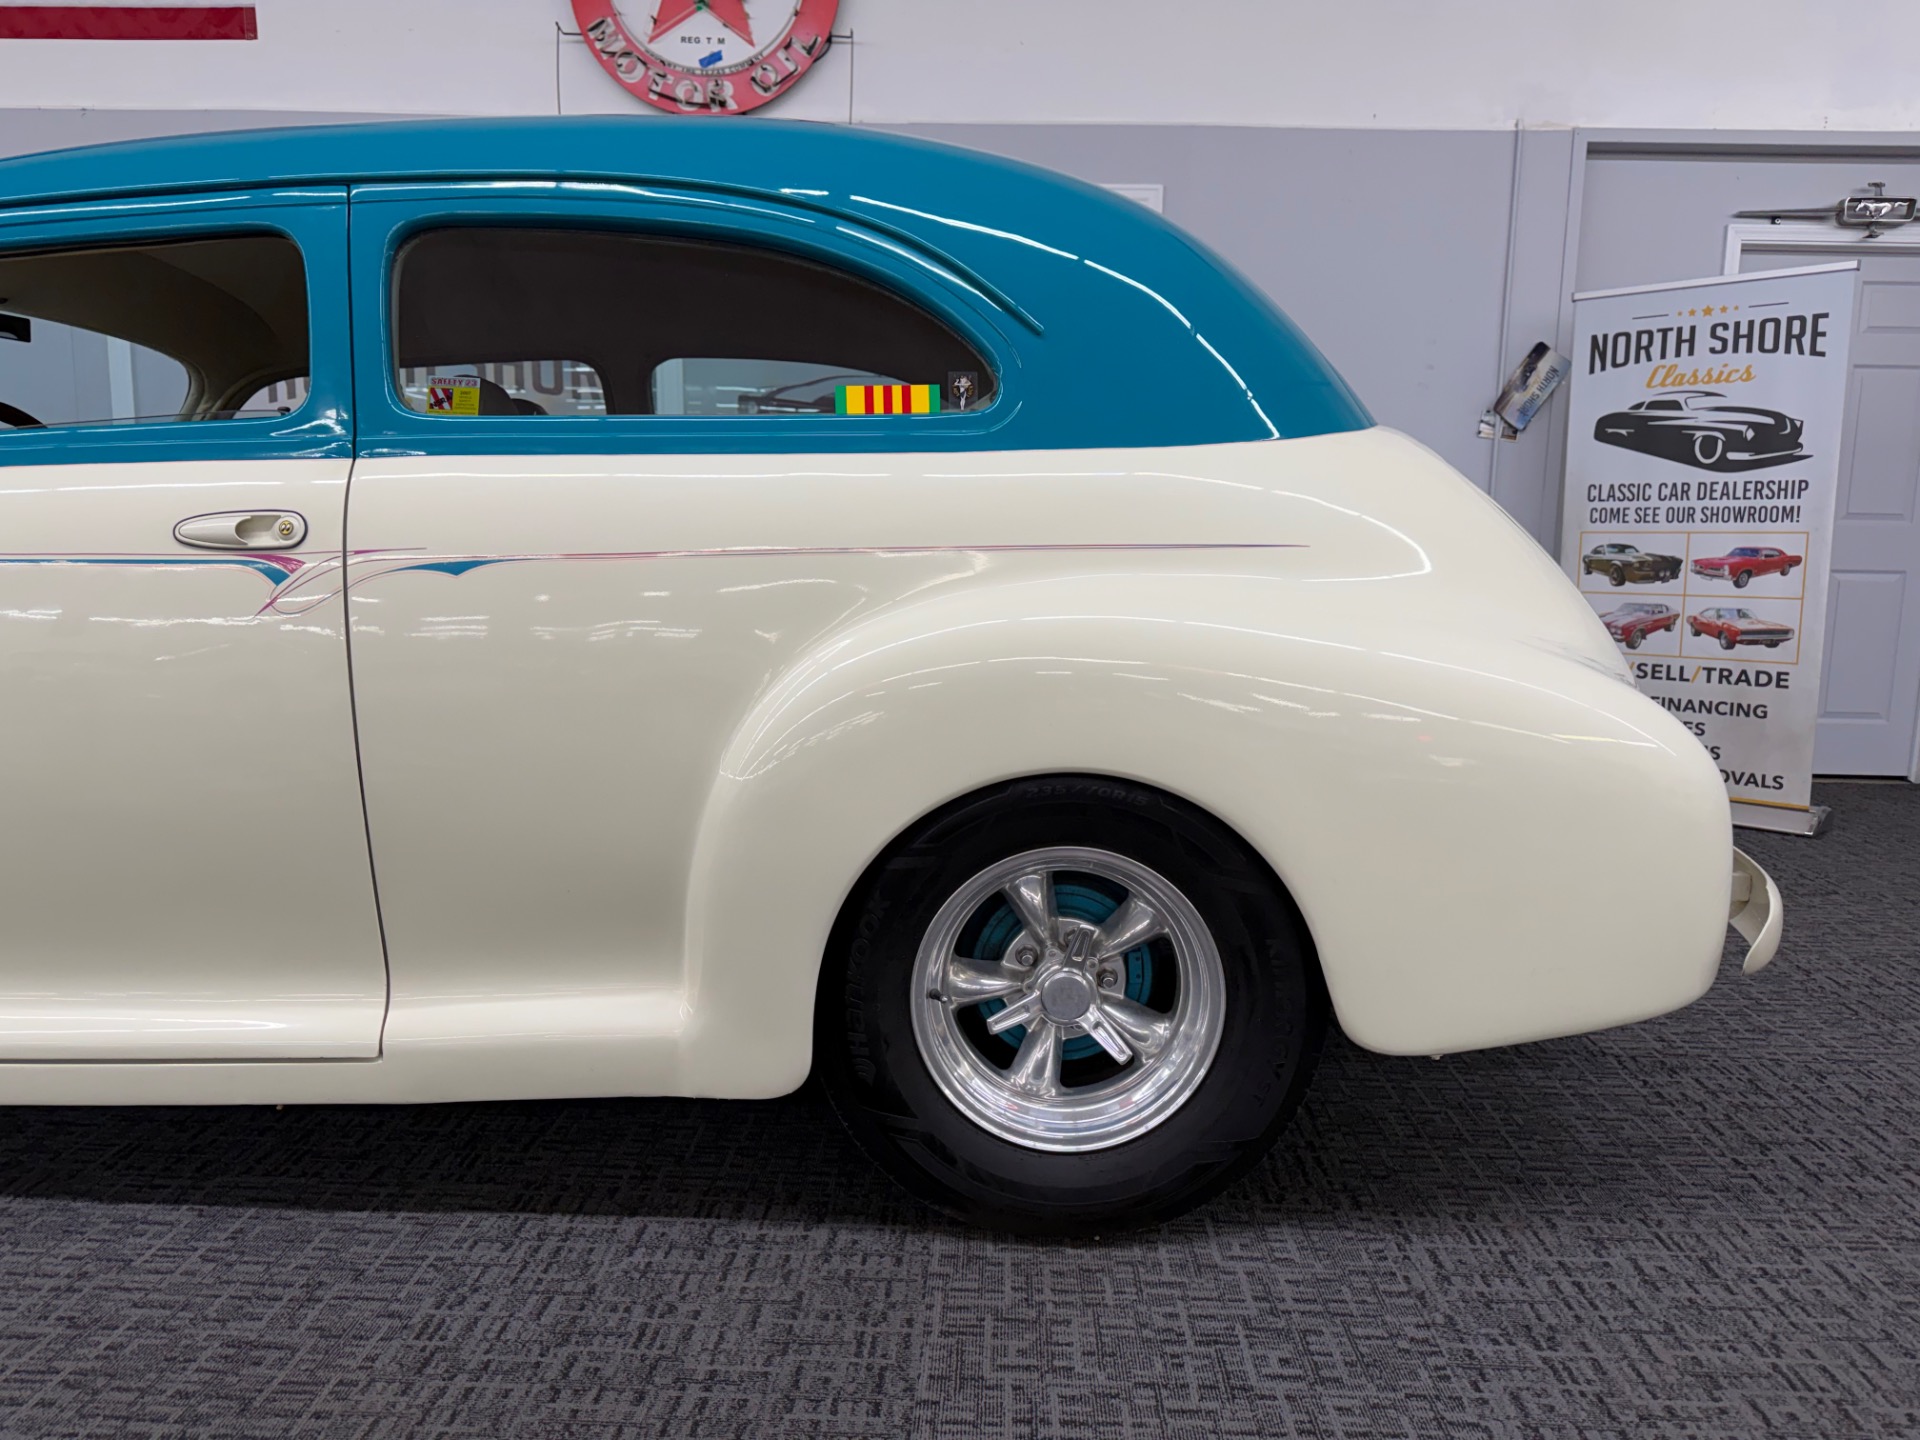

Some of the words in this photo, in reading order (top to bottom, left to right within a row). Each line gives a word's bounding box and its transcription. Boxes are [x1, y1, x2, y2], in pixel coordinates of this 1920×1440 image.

[680, 35, 701, 45] REG
[706, 36, 713, 45] T
[717, 36, 726, 45] M
[586, 17, 739, 113] MOTOR
[750, 33, 823, 96] OIL
[1588, 325, 1697, 375] NORTH
[1708, 312, 1830, 358] SHORE
[1537, 365, 1560, 395] NORTH
[1645, 362, 1757, 389] Classics
[1587, 482, 1653, 503] CLASSIC
[1657, 481, 1692, 502] CAR
[1696, 479, 1810, 501] DEALERSHIP
[1589, 506, 1630, 525] COME
[1633, 507, 1661, 524] SEE
[1665, 506, 1696, 524] OUR
[1700, 505, 1801, 524] SHOWROOM!
